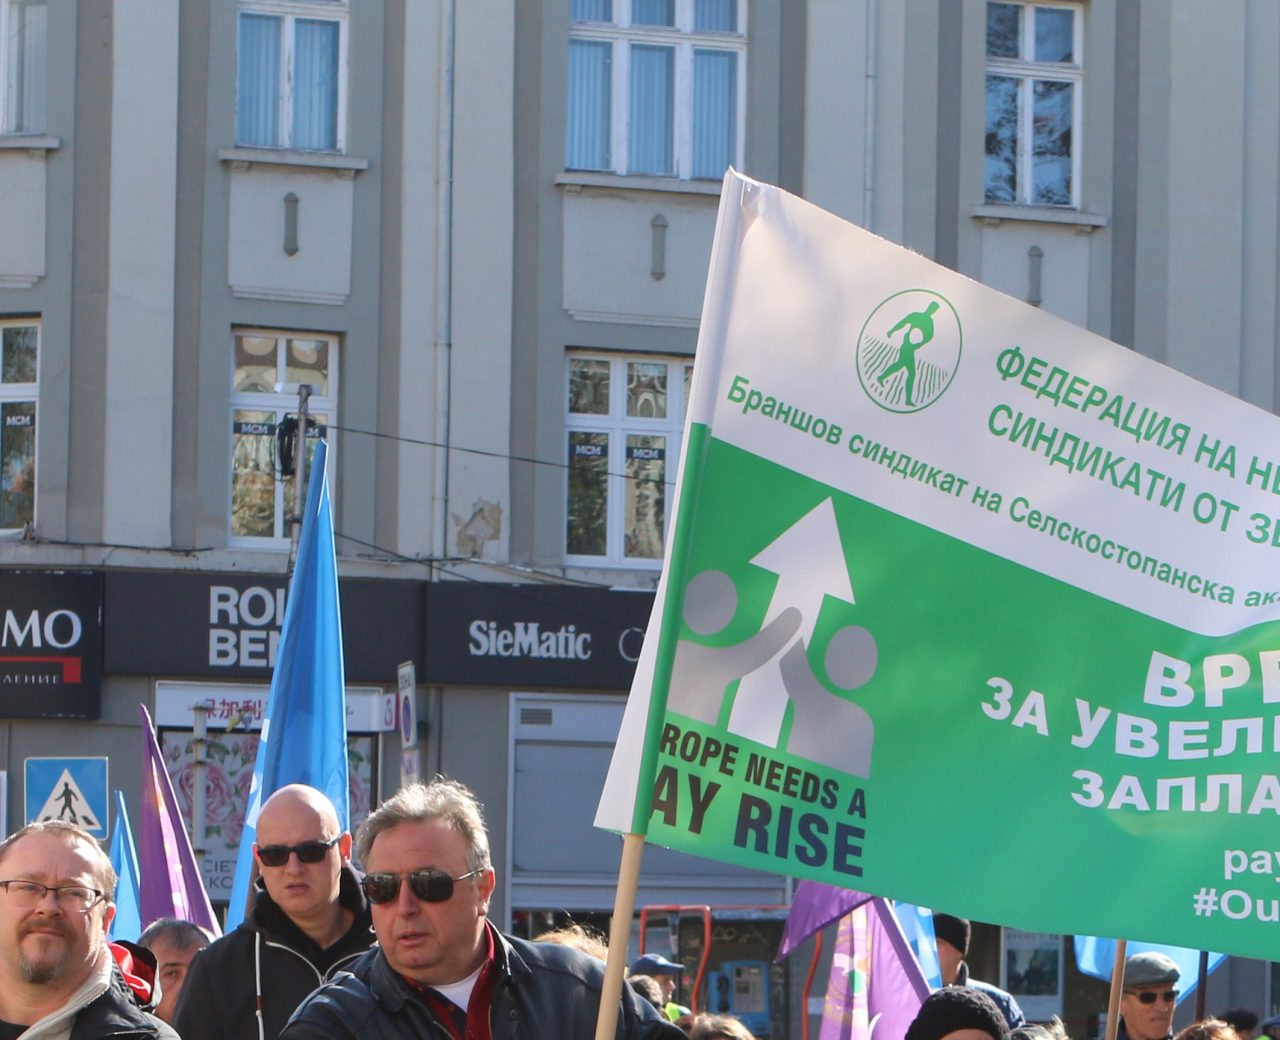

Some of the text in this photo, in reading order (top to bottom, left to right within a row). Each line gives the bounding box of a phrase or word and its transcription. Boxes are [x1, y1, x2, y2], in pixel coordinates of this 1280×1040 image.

[996, 346, 1191, 455] ФЕДЕРАЦИЯ
[1194, 432, 1237, 477] НА
[728, 375, 843, 446] Браншов
[848, 433, 968, 496] синдикат
[972, 486, 1003, 512] на
[1009, 496, 1236, 604] Селскостопанска
[988, 403, 1186, 513] СИНДИКАТИ
[1192, 491, 1242, 531] ОТ
[1, 609, 82, 648] MO
[469, 619, 592, 660] SieMatic
[3, 674, 59, 684] ЛЕНИЕ
[980, 677, 1049, 735] ЗА
[659, 723, 867, 819] ROPE NEEDS A
[649, 765, 866, 877] AY RISE
